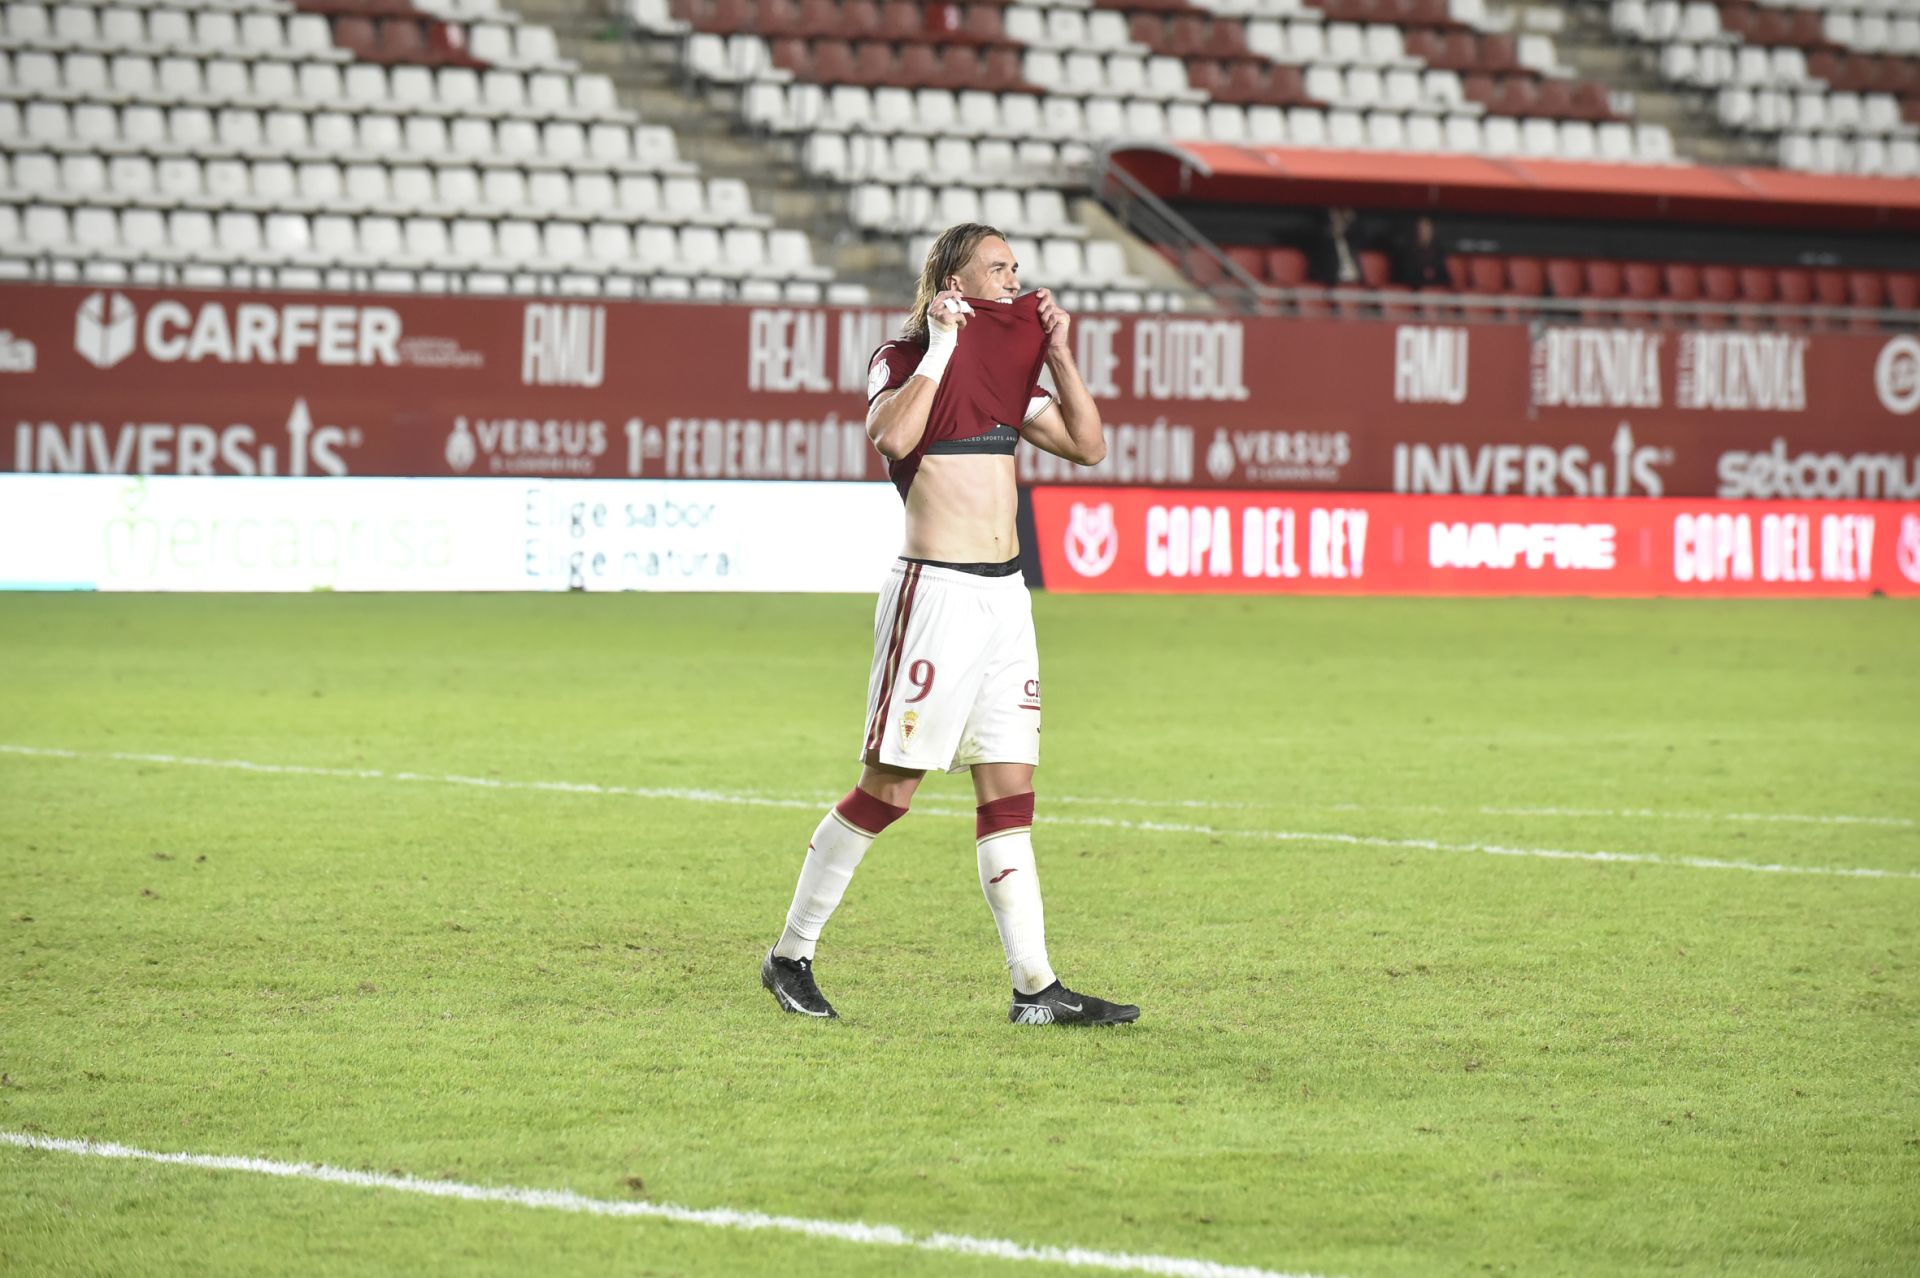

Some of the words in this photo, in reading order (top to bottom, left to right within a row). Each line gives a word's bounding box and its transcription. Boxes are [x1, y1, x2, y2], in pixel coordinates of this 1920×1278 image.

[144, 301, 402, 366] CARFER
[749, 309, 834, 392] REAL
[1077, 318, 1121, 399] DE
[475, 419, 607, 455] VERSUS
[666, 411, 867, 479] FEDERACIÓN
[1233, 429, 1351, 466] VERSUS
[623, 487, 716, 529] sabor
[1146, 506, 1233, 577] COPA
[1242, 507, 1301, 577] DEL
[1309, 508, 1368, 578] REY
[1429, 522, 1615, 570] MAPFRE
[1673, 513, 1753, 583] COPA
[1761, 513, 1814, 582] DEL
[1820, 514, 1875, 582] REY
[904, 658, 936, 704] 9
